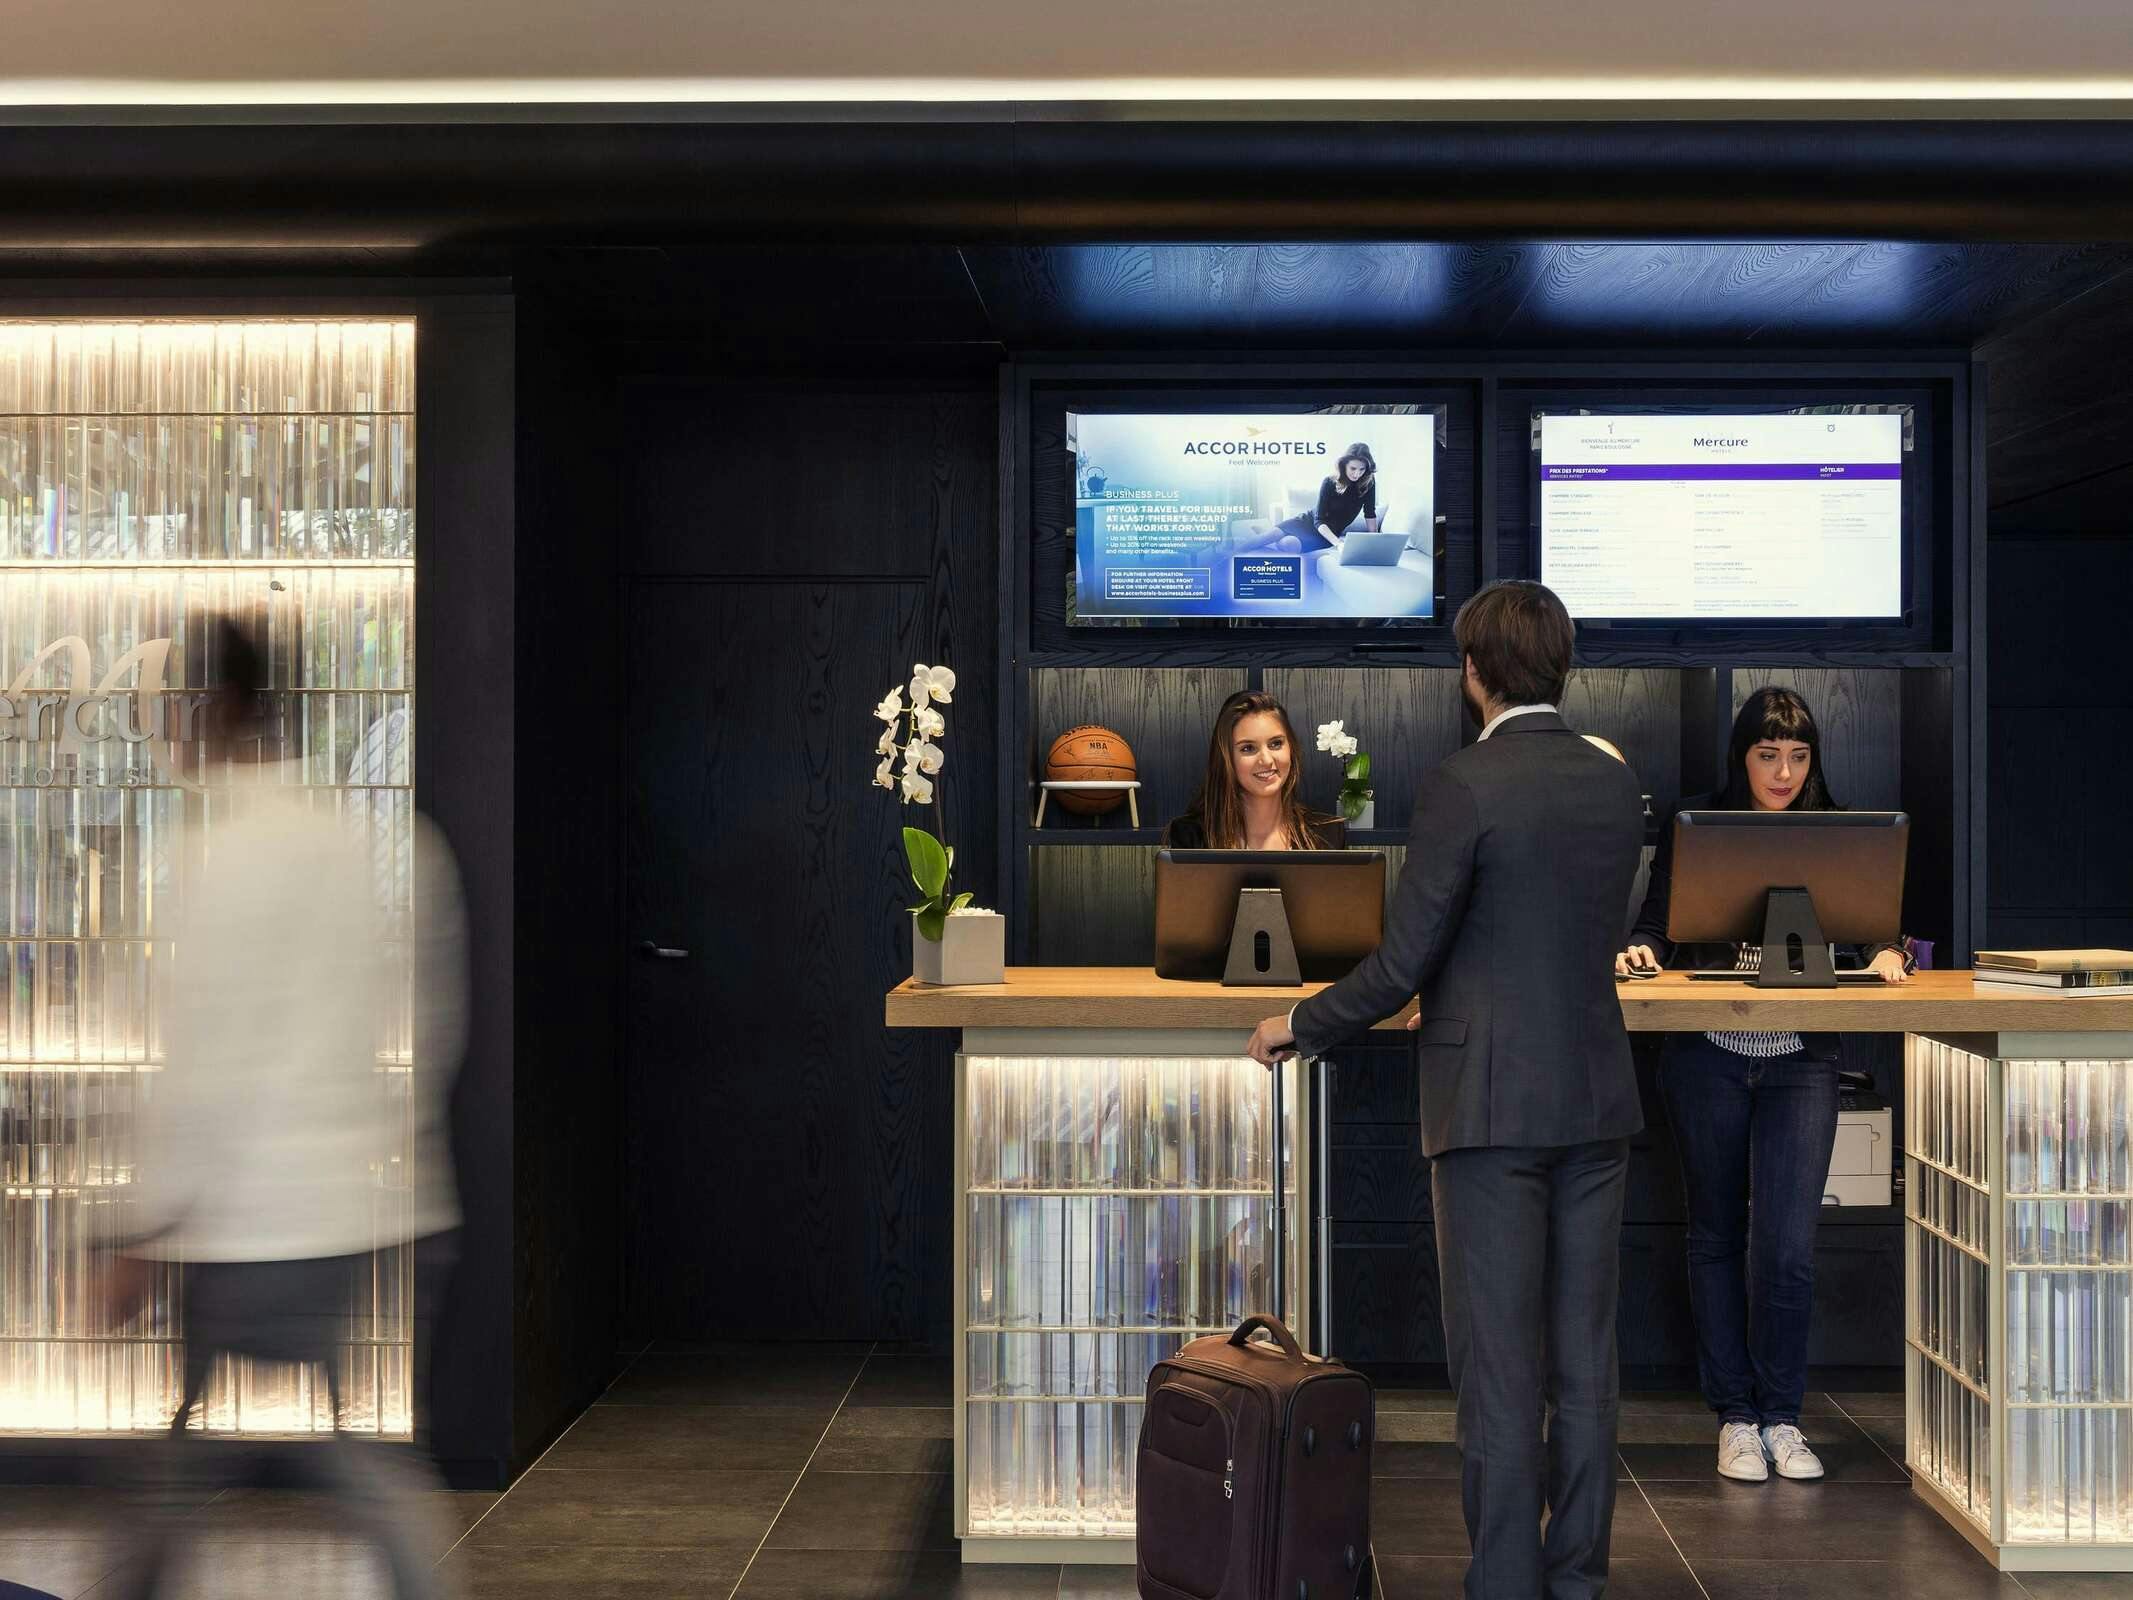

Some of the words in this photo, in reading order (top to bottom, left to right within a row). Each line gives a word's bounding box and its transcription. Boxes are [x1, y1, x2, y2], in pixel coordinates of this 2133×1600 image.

[1694, 438, 1748, 446] Mercure
[1106, 490, 1152, 498] BUSINESS
[1155, 490, 1179, 498] PLUS
[1203, 506, 1253, 514] BUSINESS,
[1090, 742, 1108, 750] NBA
